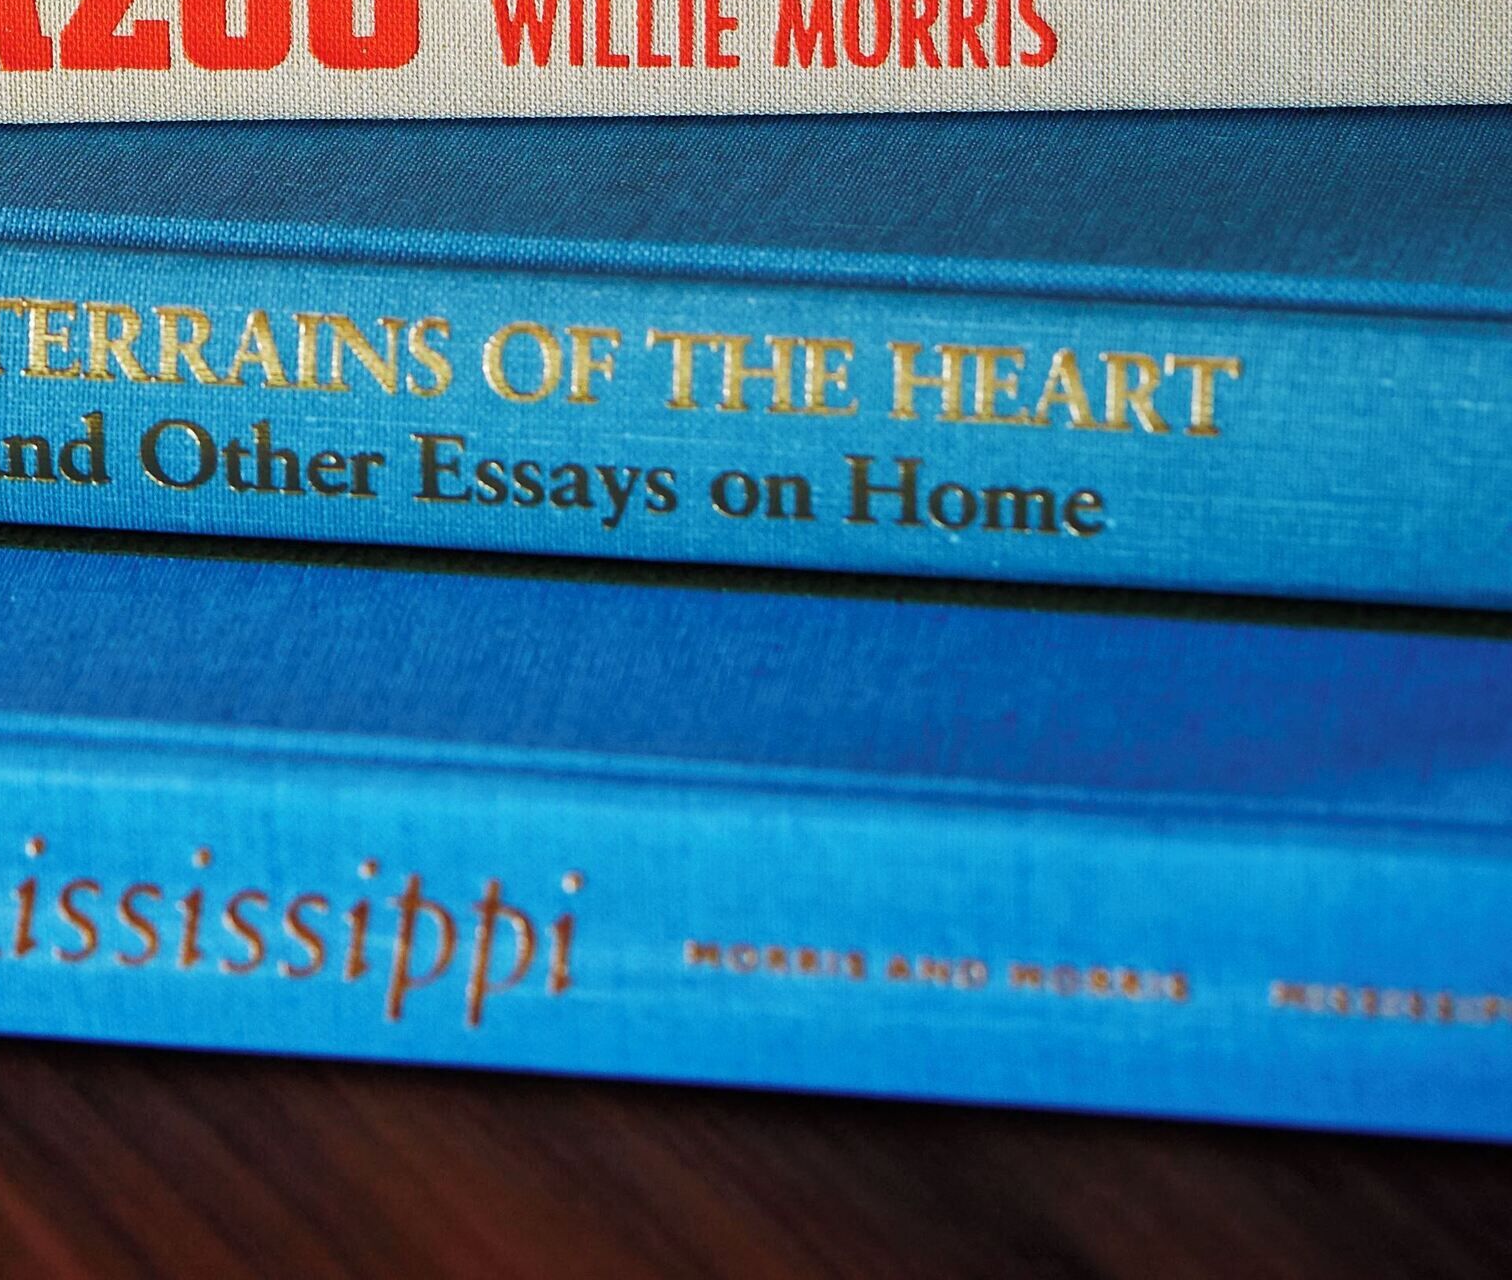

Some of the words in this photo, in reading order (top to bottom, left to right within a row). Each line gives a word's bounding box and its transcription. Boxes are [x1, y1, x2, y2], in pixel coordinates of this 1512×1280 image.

[483, 320, 622, 404] OF
[646, 326, 858, 416] THE
[887, 341, 1243, 436] HEART
[139, 417, 383, 500] Other
[410, 432, 678, 530] Essays
[709, 469, 816, 522] on
[843, 454, 1107, 537] Home
